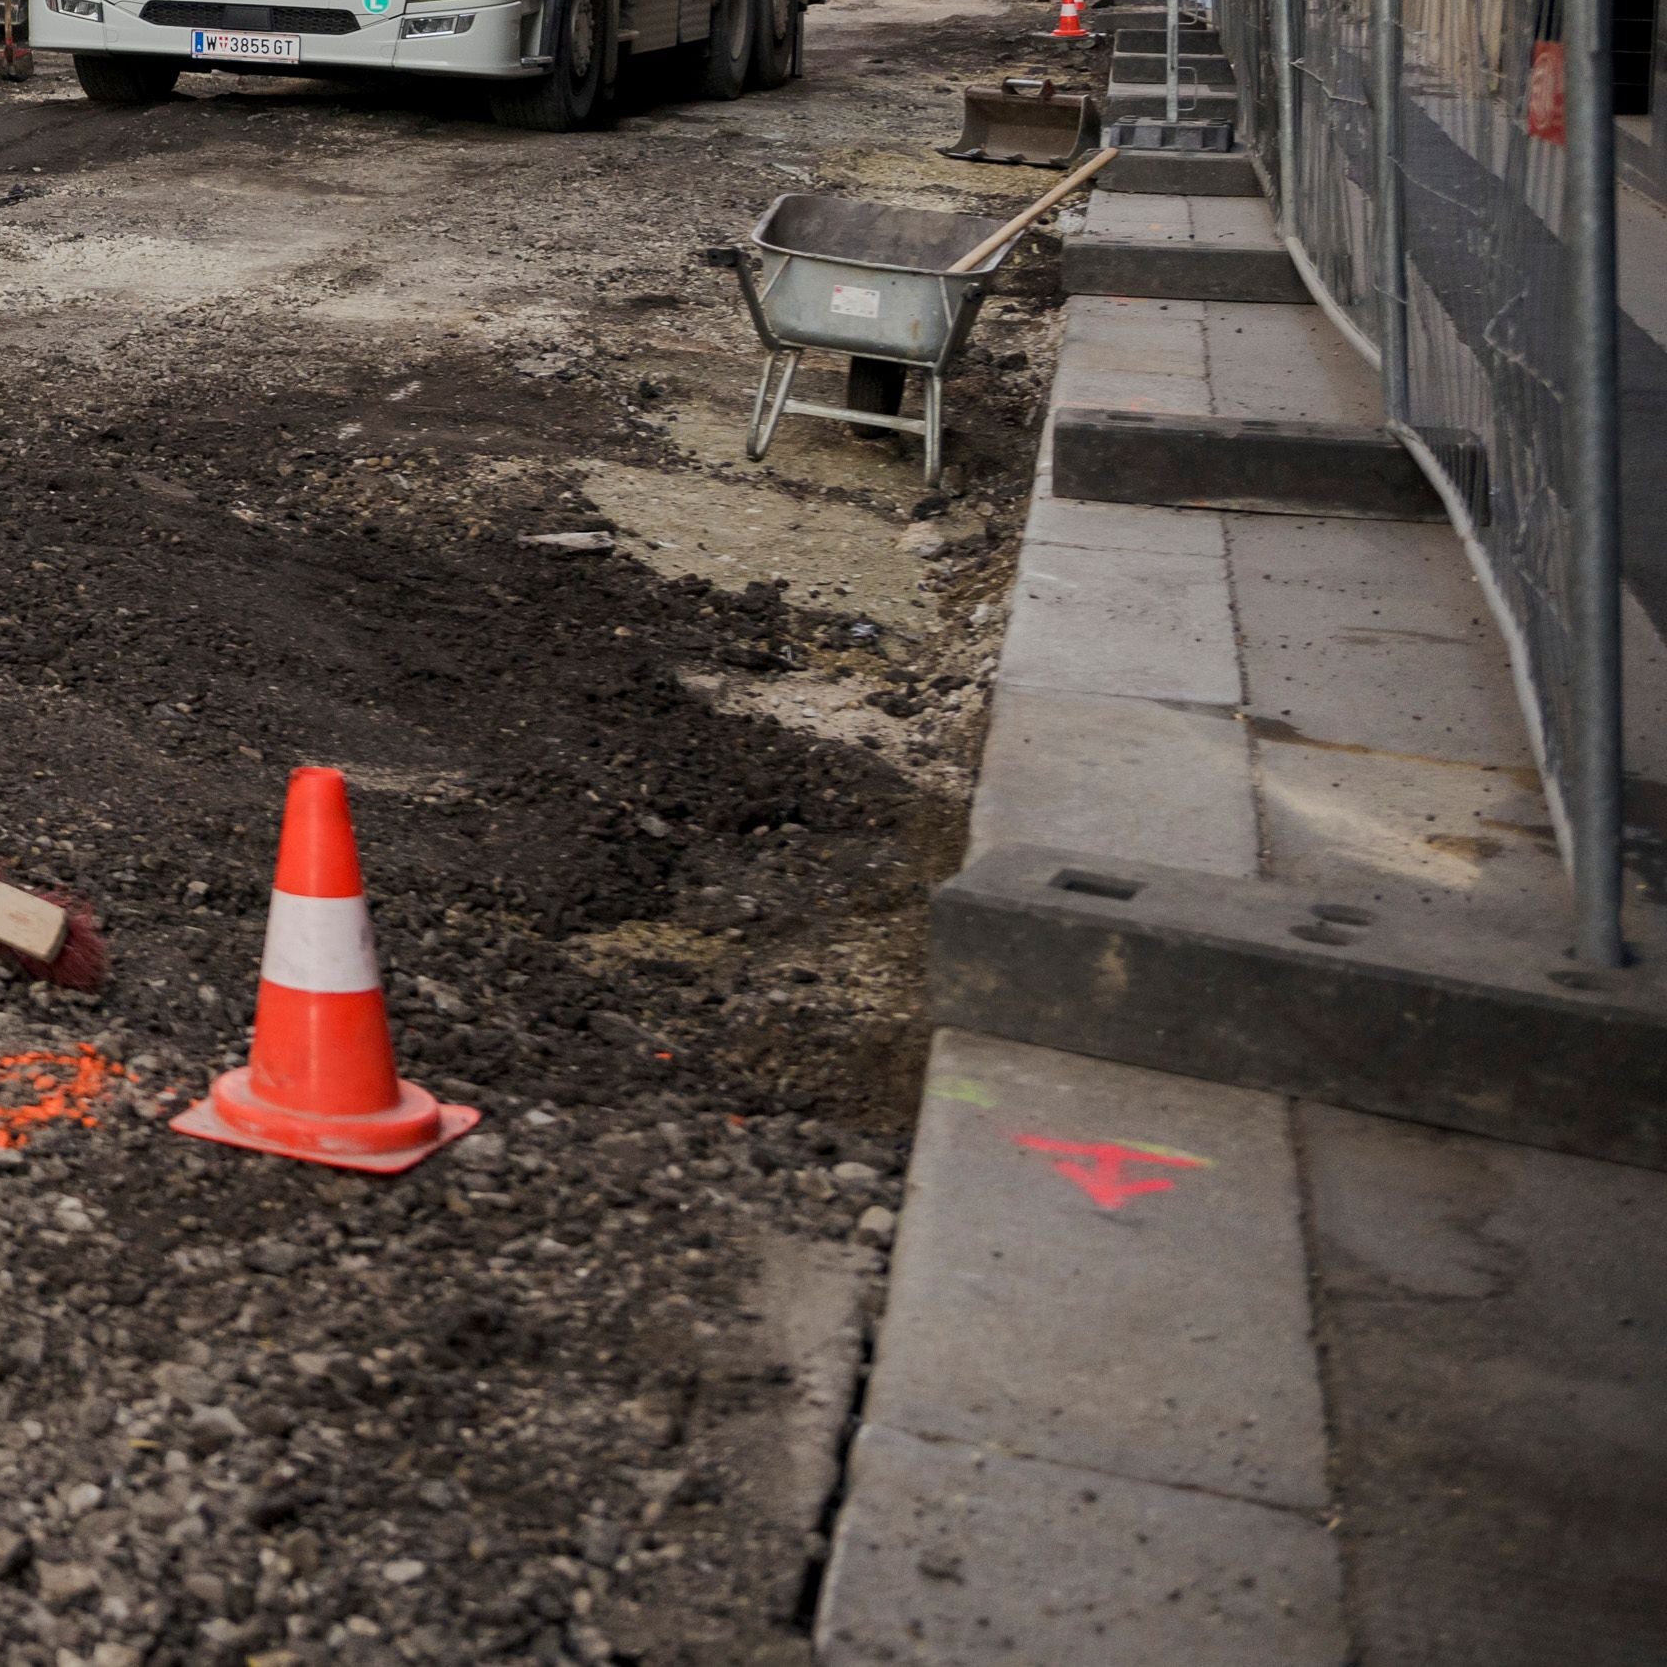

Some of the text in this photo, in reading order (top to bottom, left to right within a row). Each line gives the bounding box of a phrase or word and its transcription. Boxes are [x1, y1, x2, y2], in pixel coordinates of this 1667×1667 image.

[206, 35, 294, 56] W 3855 GT
